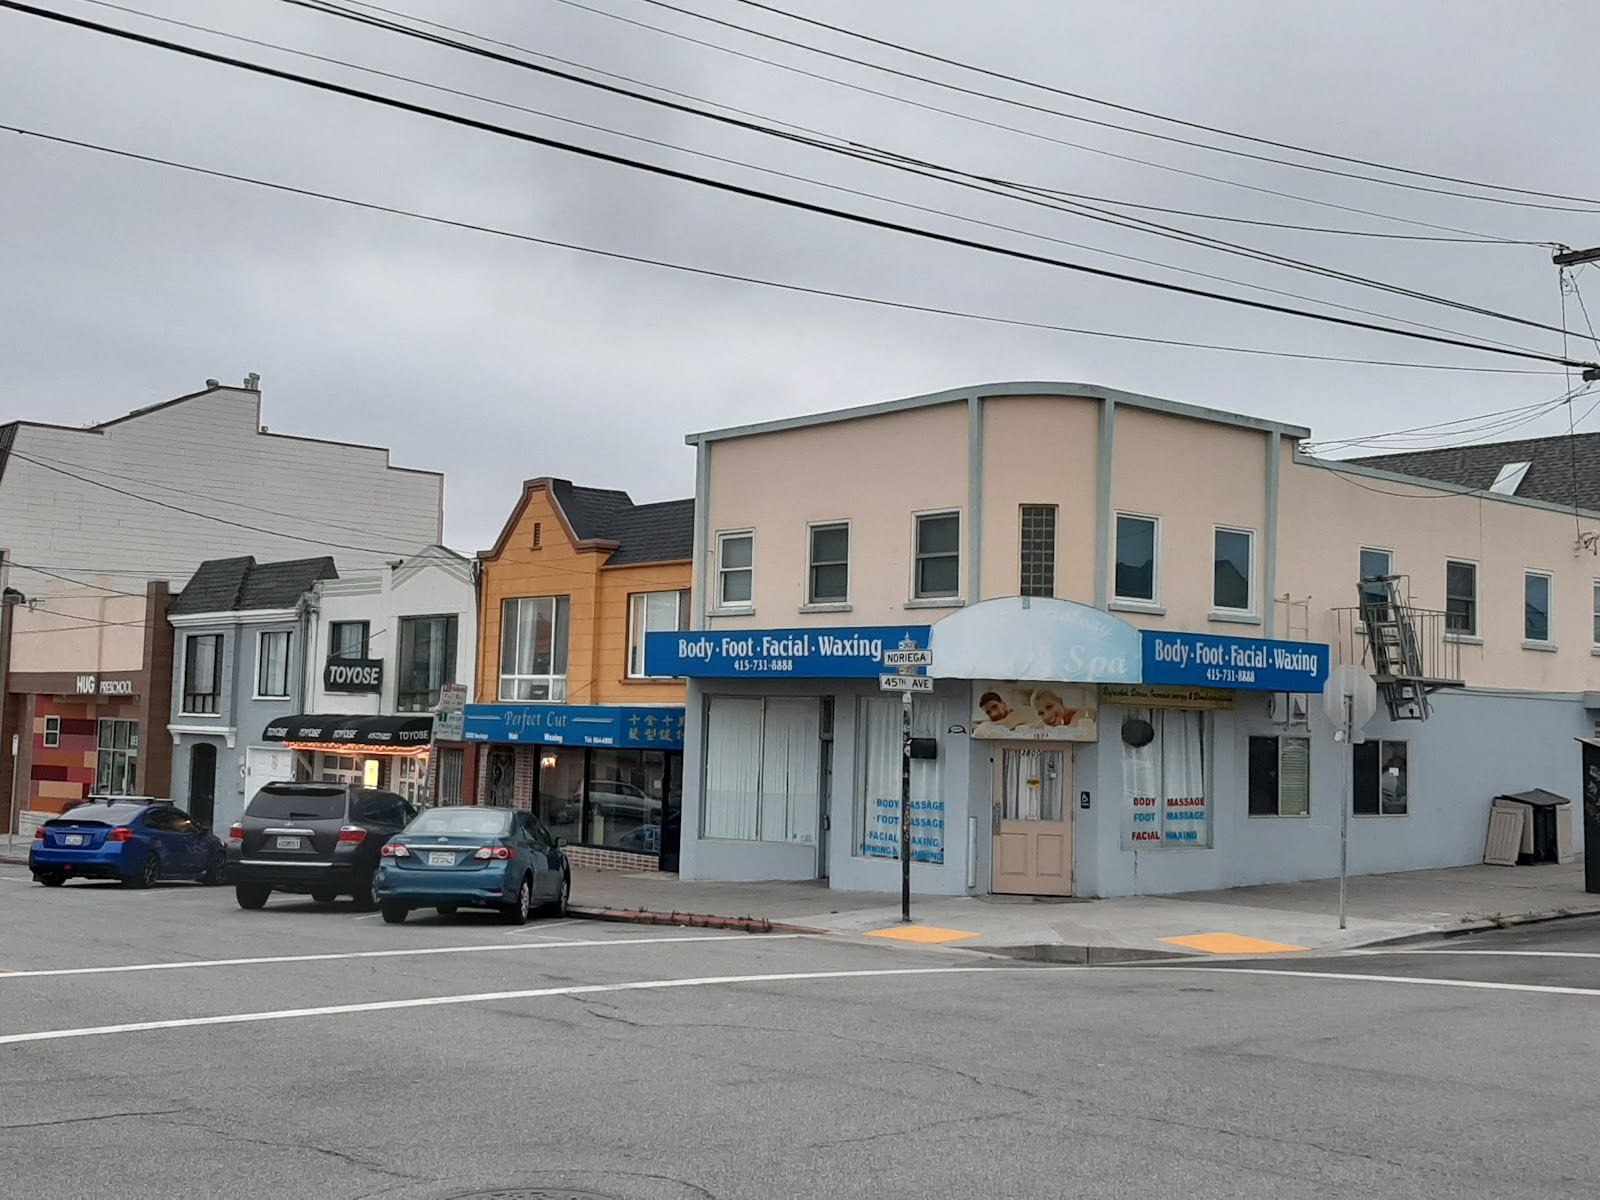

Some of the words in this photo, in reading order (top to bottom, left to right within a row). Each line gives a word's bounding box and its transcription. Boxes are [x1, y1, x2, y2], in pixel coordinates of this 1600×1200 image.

[679, 639, 714, 662] Body
[722, 637, 754, 657] Foot
[762, 635, 809, 656] Facial
[818, 633, 882, 662] Waxing
[887, 652, 926, 663] NORIEGA
[1155, 639, 1189, 668] Body
[1196, 642, 1224, 666] Foot
[1231, 644, 1267, 668] Facial
[1274, 648, 1318, 677] Waxing
[734, 659, 793, 671] 415-731-8888
[329, 665, 380, 685] TOYOSE
[1206, 667, 1256, 683] 415-731-8888
[76, 675, 96, 694] HUG
[99, 680, 132, 695] PRESCHOOL
[884, 677, 906, 688] 45TH
[911, 679, 930, 689] AVE
[504, 706, 541, 734] Perfect
[547, 711, 567, 728] Cut
[332, 729, 358, 739] TOYOSE
[399, 729, 429, 740] TOYOSE
[876, 798, 900, 809] BODY
[911, 801, 945, 812] ASSAGE
[1133, 797, 1157, 807] BODY
[1166, 797, 1205, 807] MASSAGE
[876, 814, 900, 825] FOOT
[911, 817, 945, 829] ASSAGE
[1133, 812, 1156, 822] FOOT
[1166, 811, 1205, 821] MASSAGE
[868, 831, 898, 843] FACIAL
[911, 836, 940, 848] AXING
[1131, 831, 1160, 841] FACIAL
[1165, 831, 1198, 841] WAXING
